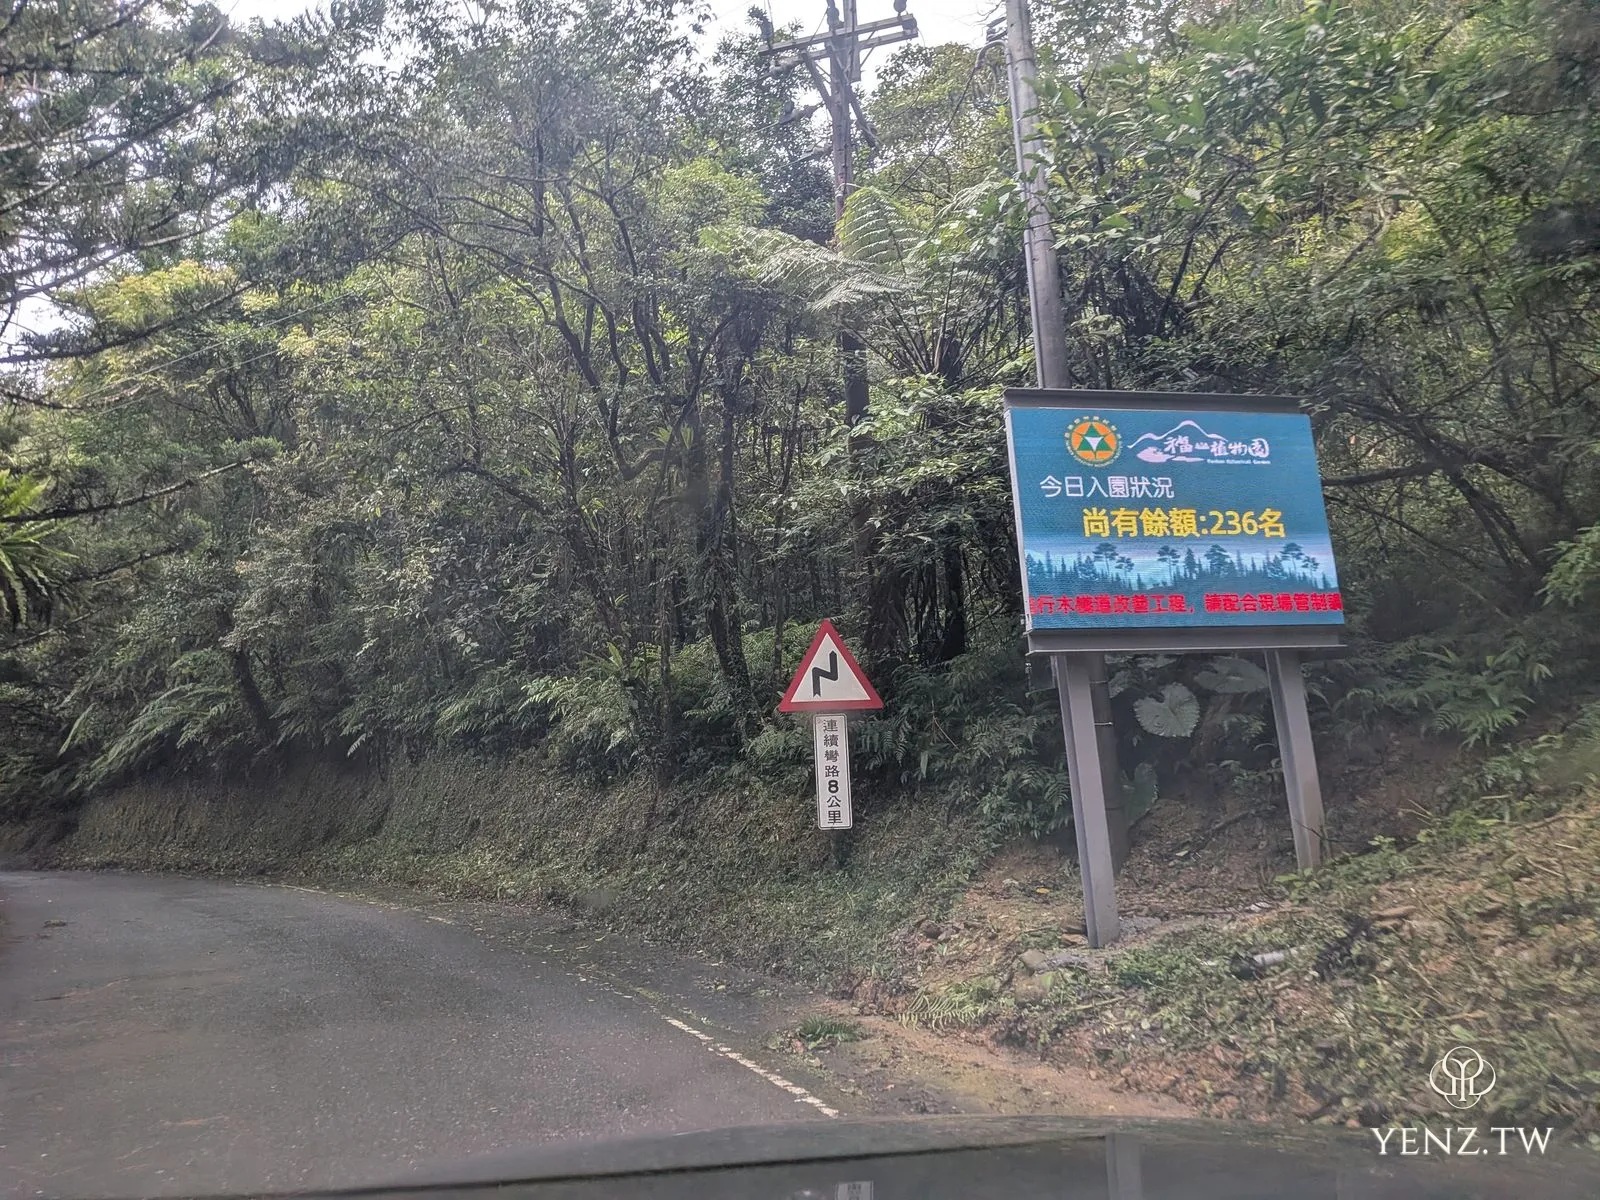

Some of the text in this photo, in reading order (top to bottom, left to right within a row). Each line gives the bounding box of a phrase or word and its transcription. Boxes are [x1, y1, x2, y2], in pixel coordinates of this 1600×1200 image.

[1163, 435, 1270, 458] 福山植物園
[1039, 475, 1175, 499] 今日入園狀況
[1083, 507, 1287, 538] 尚有餘額:236名
[822, 719, 843, 825] 連續彎路8公里
